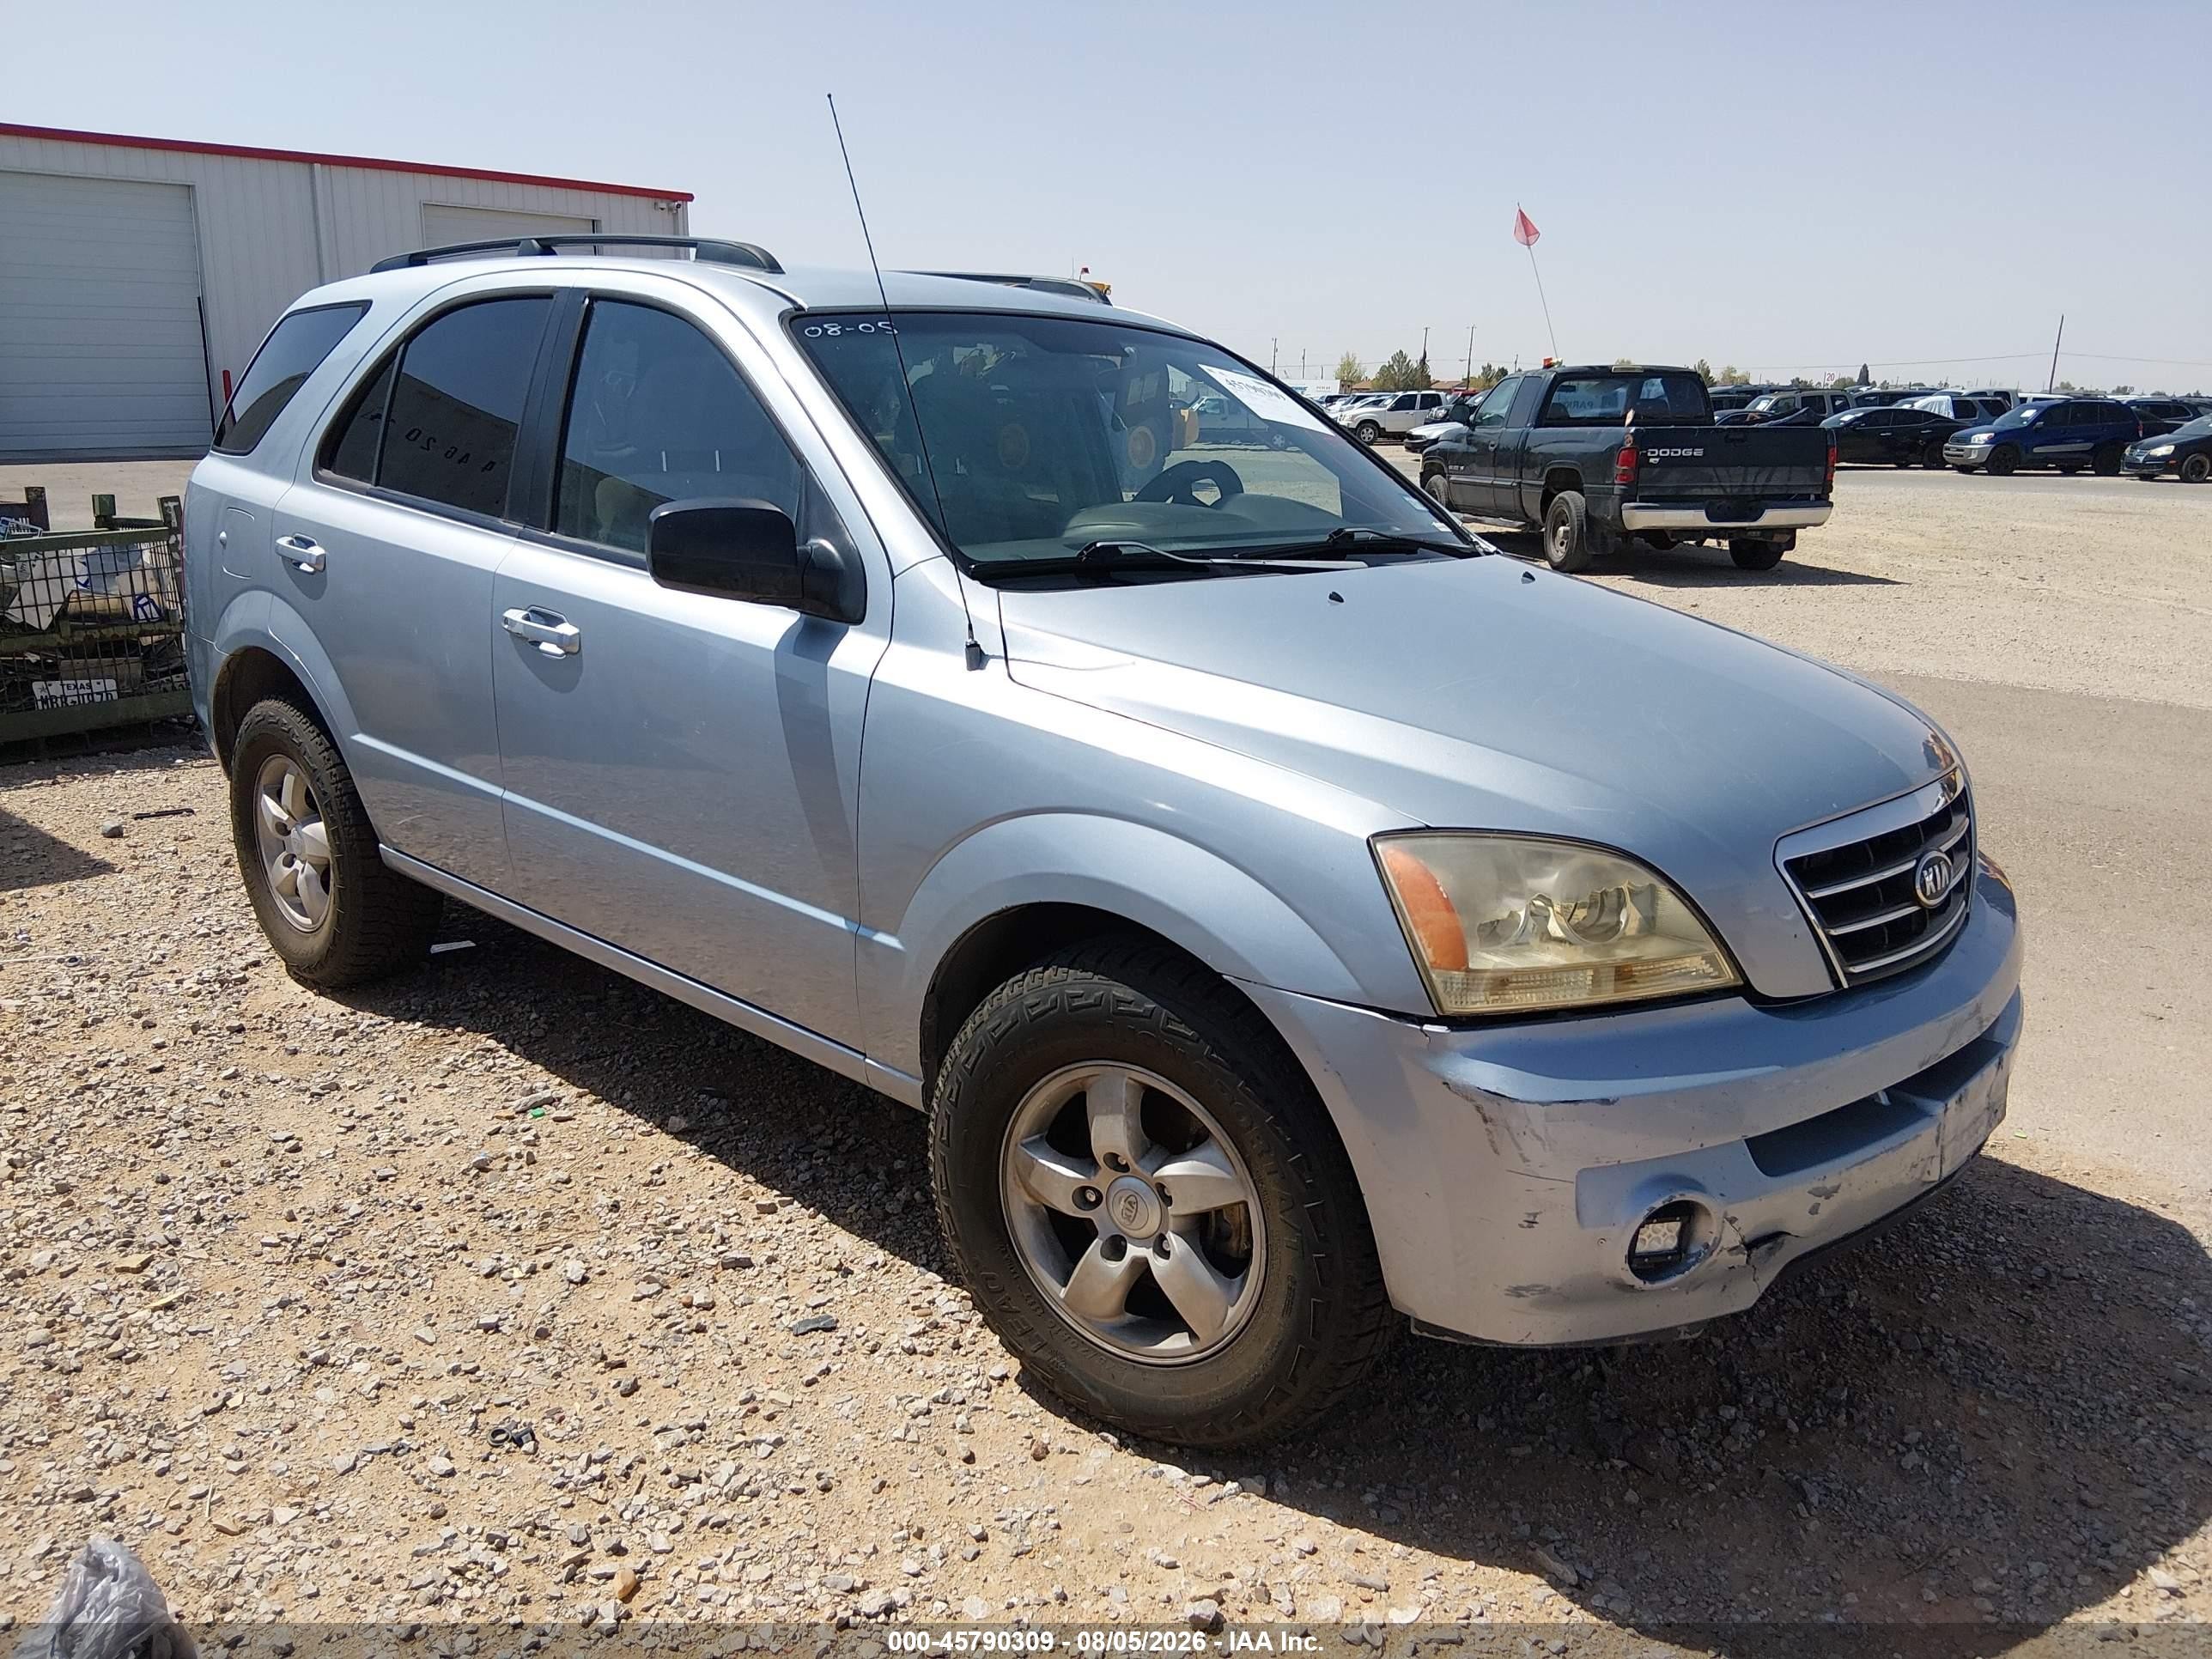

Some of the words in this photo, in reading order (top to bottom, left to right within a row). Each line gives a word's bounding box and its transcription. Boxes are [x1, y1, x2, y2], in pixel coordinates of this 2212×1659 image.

[805, 321, 898, 337] 08-05
[1826, 373, 1835, 381] 20
[1647, 448, 1704, 457] DODGE
[60, 683, 92, 691] TEXAS
[1923, 861, 1949, 896] KIA
